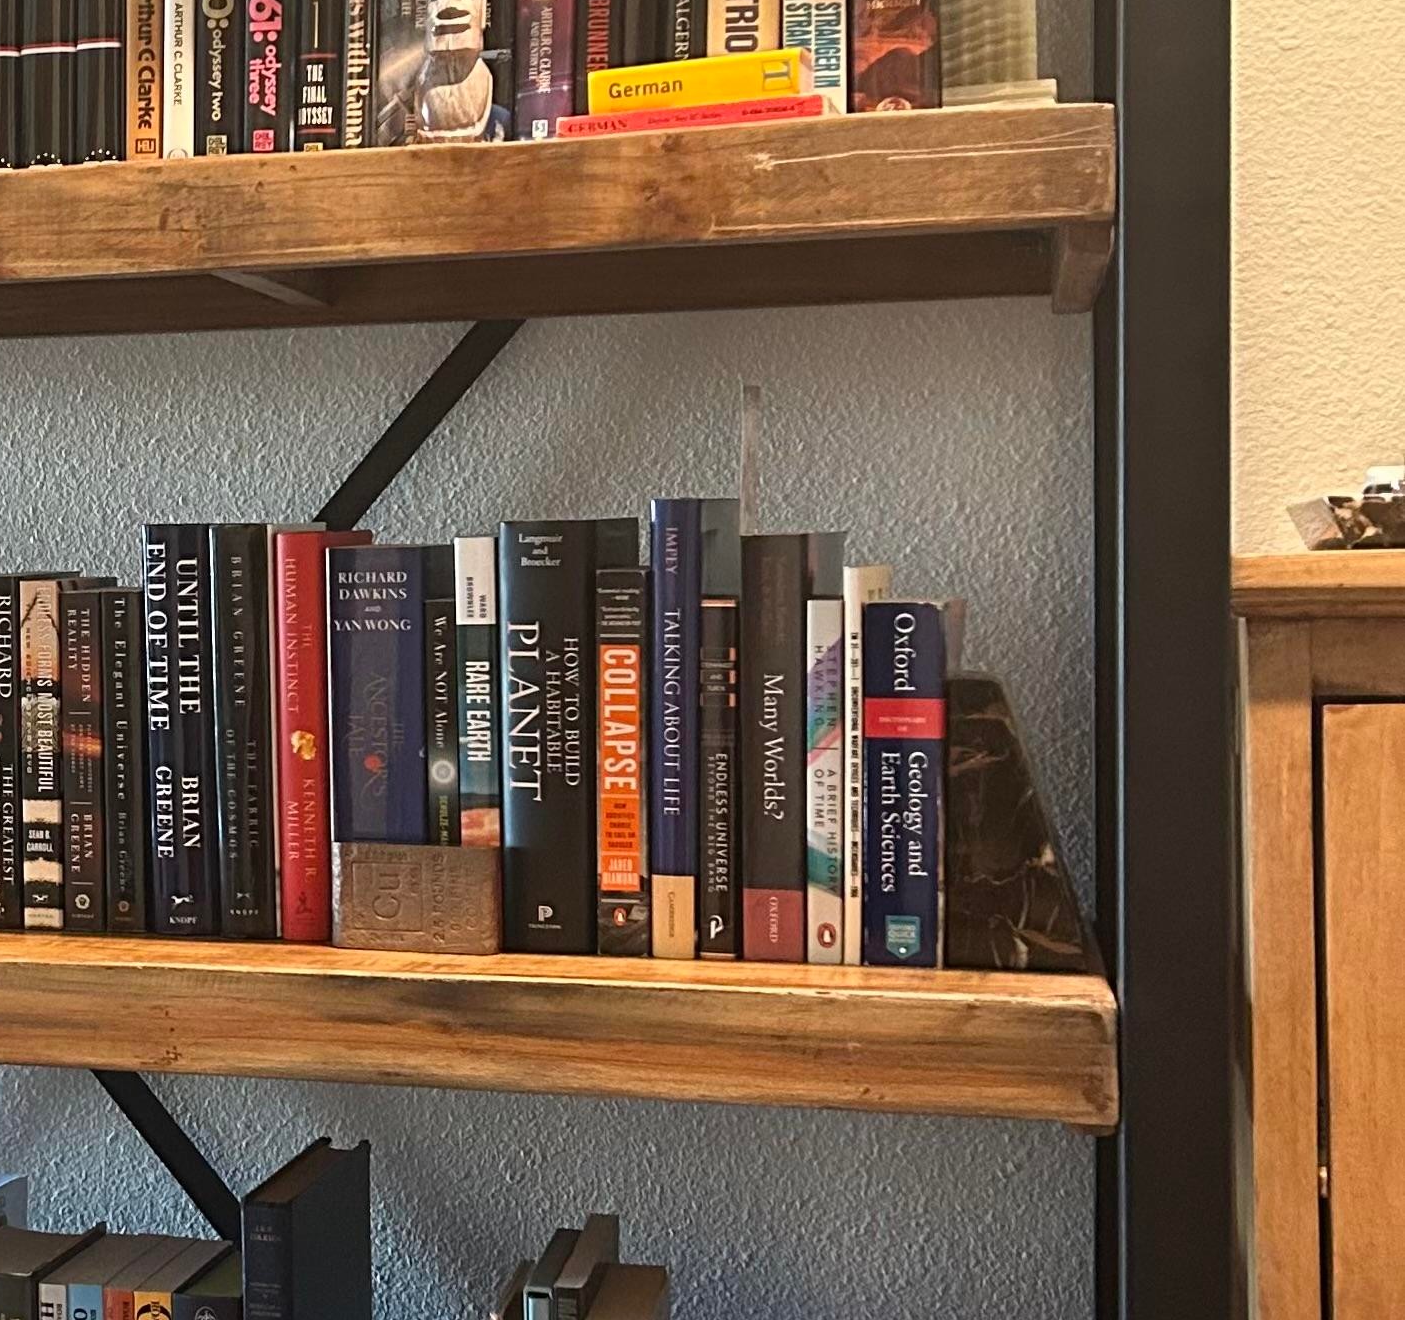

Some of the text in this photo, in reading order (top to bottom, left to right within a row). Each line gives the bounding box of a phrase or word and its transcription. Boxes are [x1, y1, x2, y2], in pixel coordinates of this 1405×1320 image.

[609, 79, 683, 98] German
[146, 542, 170, 731] END OF TIME
[176, 558, 200, 715] UNTIL THE
[895, 612, 916, 692] Oxford
[466, 660, 491, 762] RARE EARTH
[508, 622, 541, 801] PLANET
[604, 648, 637, 790] COLLAPSE
[663, 608, 680, 816] TALKING ABOUT LIFE
[764, 673, 784, 821] Many Worlds?
[155, 766, 173, 858] GREENE
[182, 777, 200, 848] BRIAN
